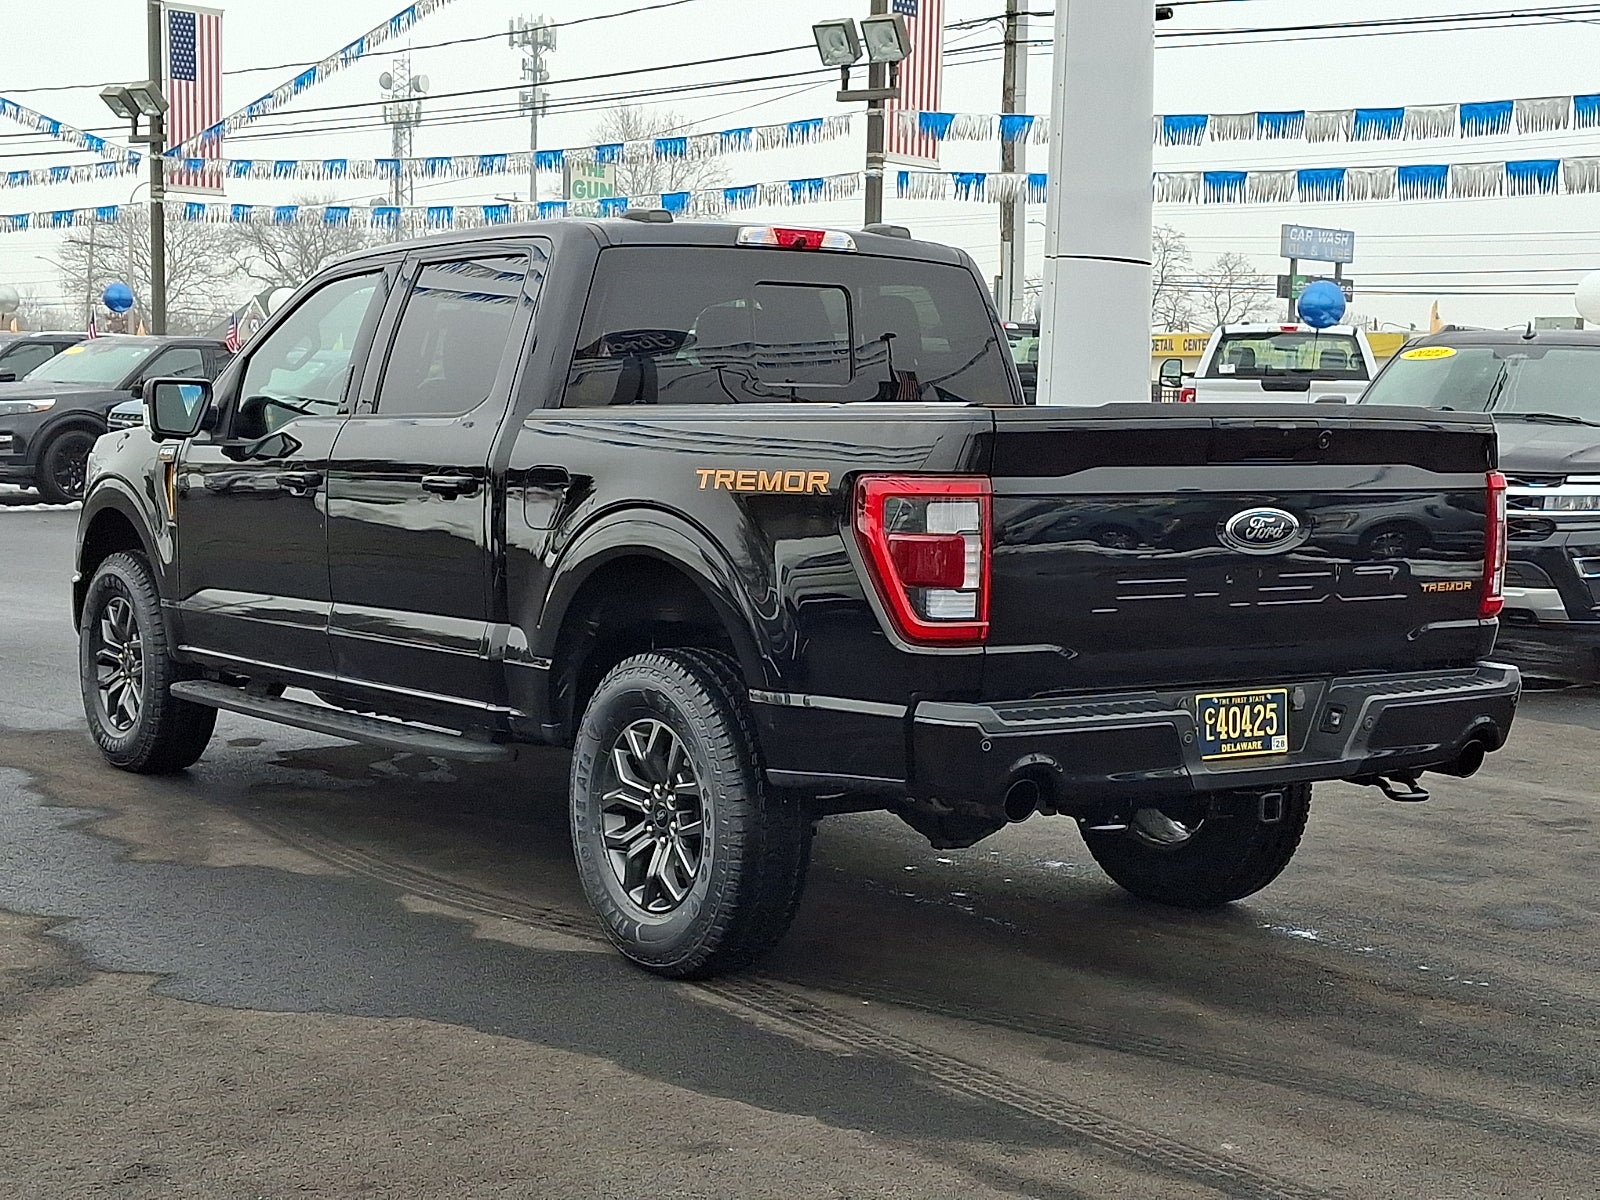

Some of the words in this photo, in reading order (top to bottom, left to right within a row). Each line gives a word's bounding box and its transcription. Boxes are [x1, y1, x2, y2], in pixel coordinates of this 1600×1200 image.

[580, 162, 607, 178] THE
[572, 180, 613, 199] GUN
[1289, 228, 1313, 242] CAR
[1318, 231, 1350, 246] WASH
[1183, 338, 1209, 352] CENTE
[695, 469, 830, 493] TREMOR
[1245, 516, 1286, 540] Ford
[1420, 581, 1472, 593] TREMOR
[1231, 696, 1247, 704] FIRST
[1248, 695, 1265, 703] STATE
[1216, 703, 1278, 740] 40425
[1221, 741, 1263, 753] DELAWARE
